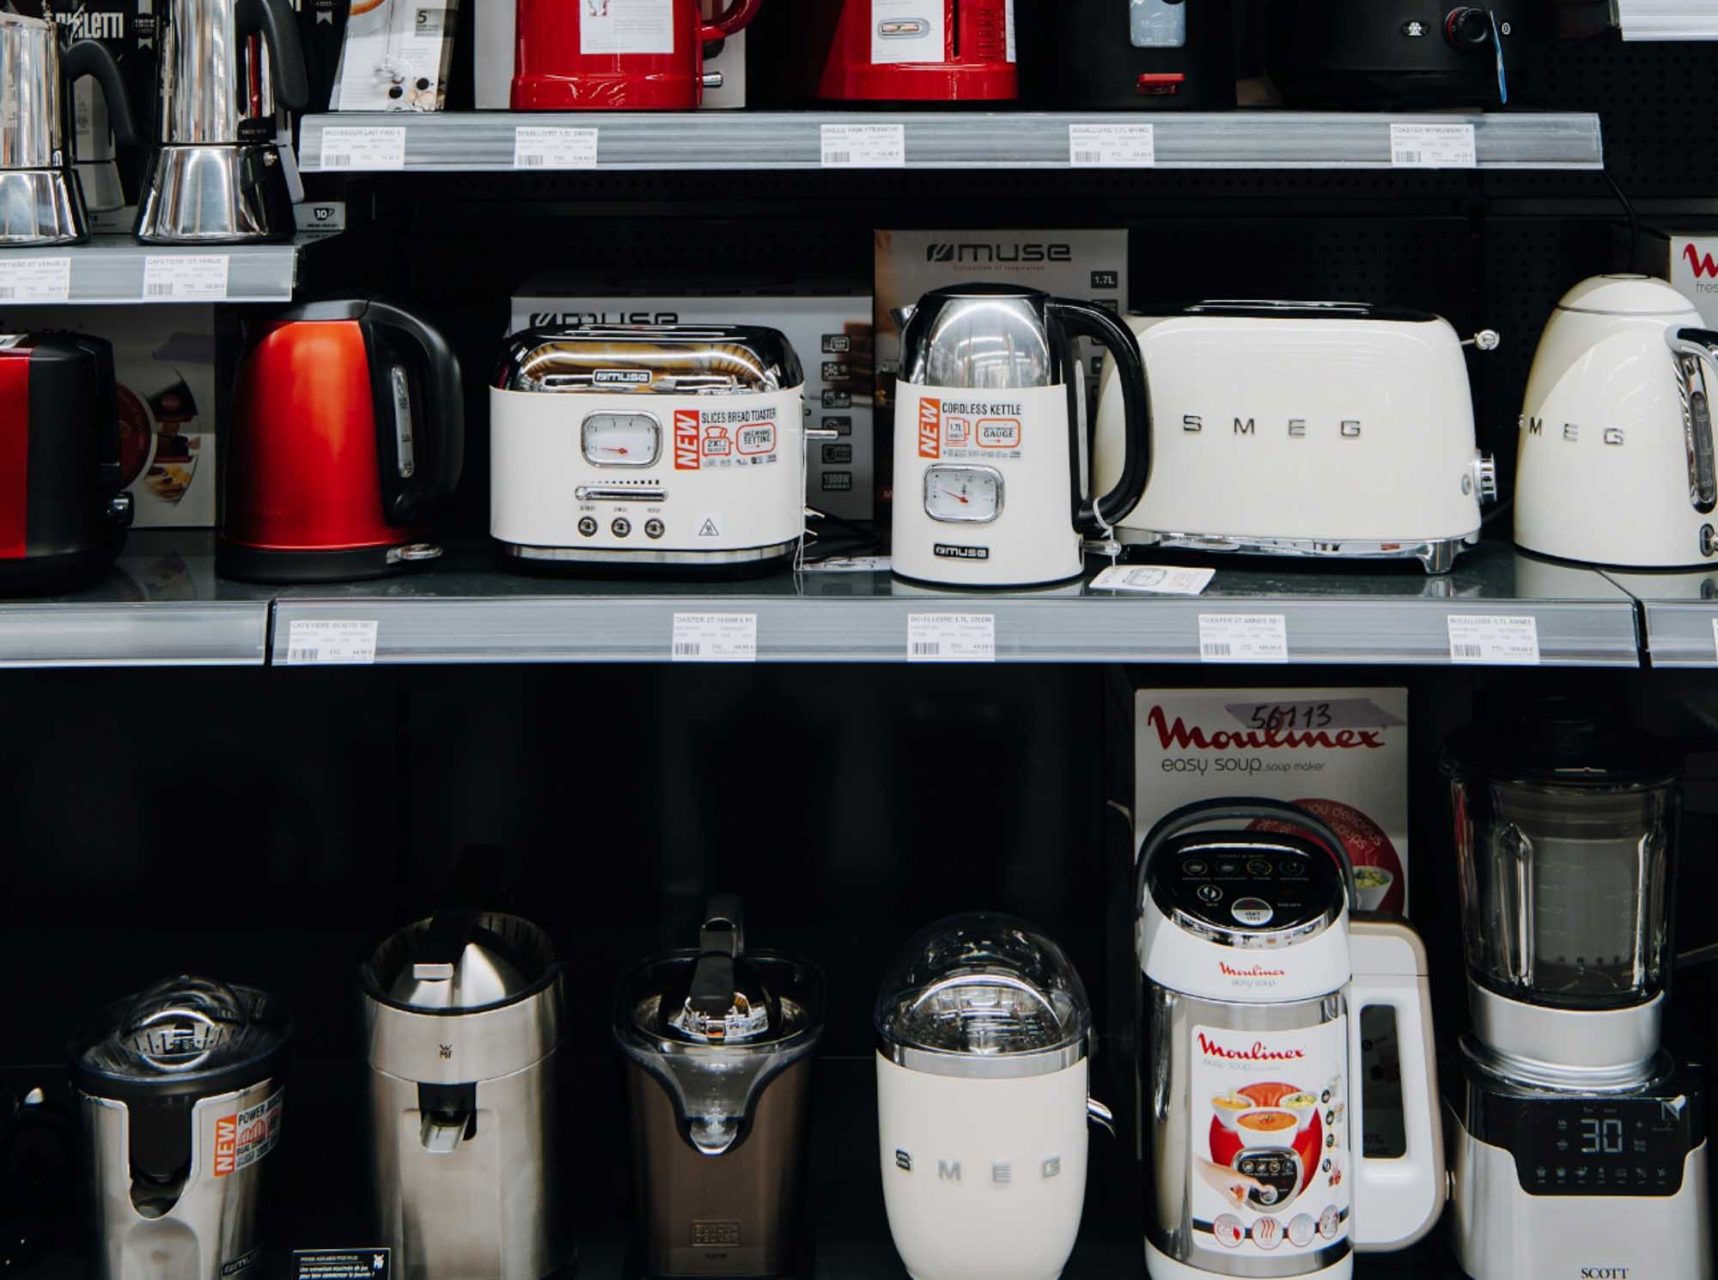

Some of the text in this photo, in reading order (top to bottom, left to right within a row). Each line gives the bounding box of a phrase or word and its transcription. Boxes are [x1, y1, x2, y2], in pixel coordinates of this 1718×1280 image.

[315, 208, 328, 219] 10
[957, 244, 1073, 263] muse
[1094, 275, 1115, 284] 1.7L
[701, 408, 777, 424] SLICES BREAD TOASTER
[942, 402, 1021, 416] CORDLESS KETTLE
[919, 400, 939, 457] NEW
[983, 430, 1014, 438] GAUGE
[1182, 414, 1361, 438] SMEG
[1518, 415, 1626, 446] MEG
[675, 413, 699, 468] NEW
[1147, 705, 1386, 751] Moulinex
[1161, 758, 1208, 777] easy
[1214, 757, 1262, 777] soup
[1293, 762, 1326, 771] maker
[1219, 961, 1285, 976] Moulinex
[1197, 1032, 1305, 1060] Moulinex
[216, 1121, 236, 1172] NEW
[1580, 1119, 1623, 1153] 30
[895, 1149, 1061, 1186] SMEG
[1580, 1268, 1629, 1280] SCOTT
